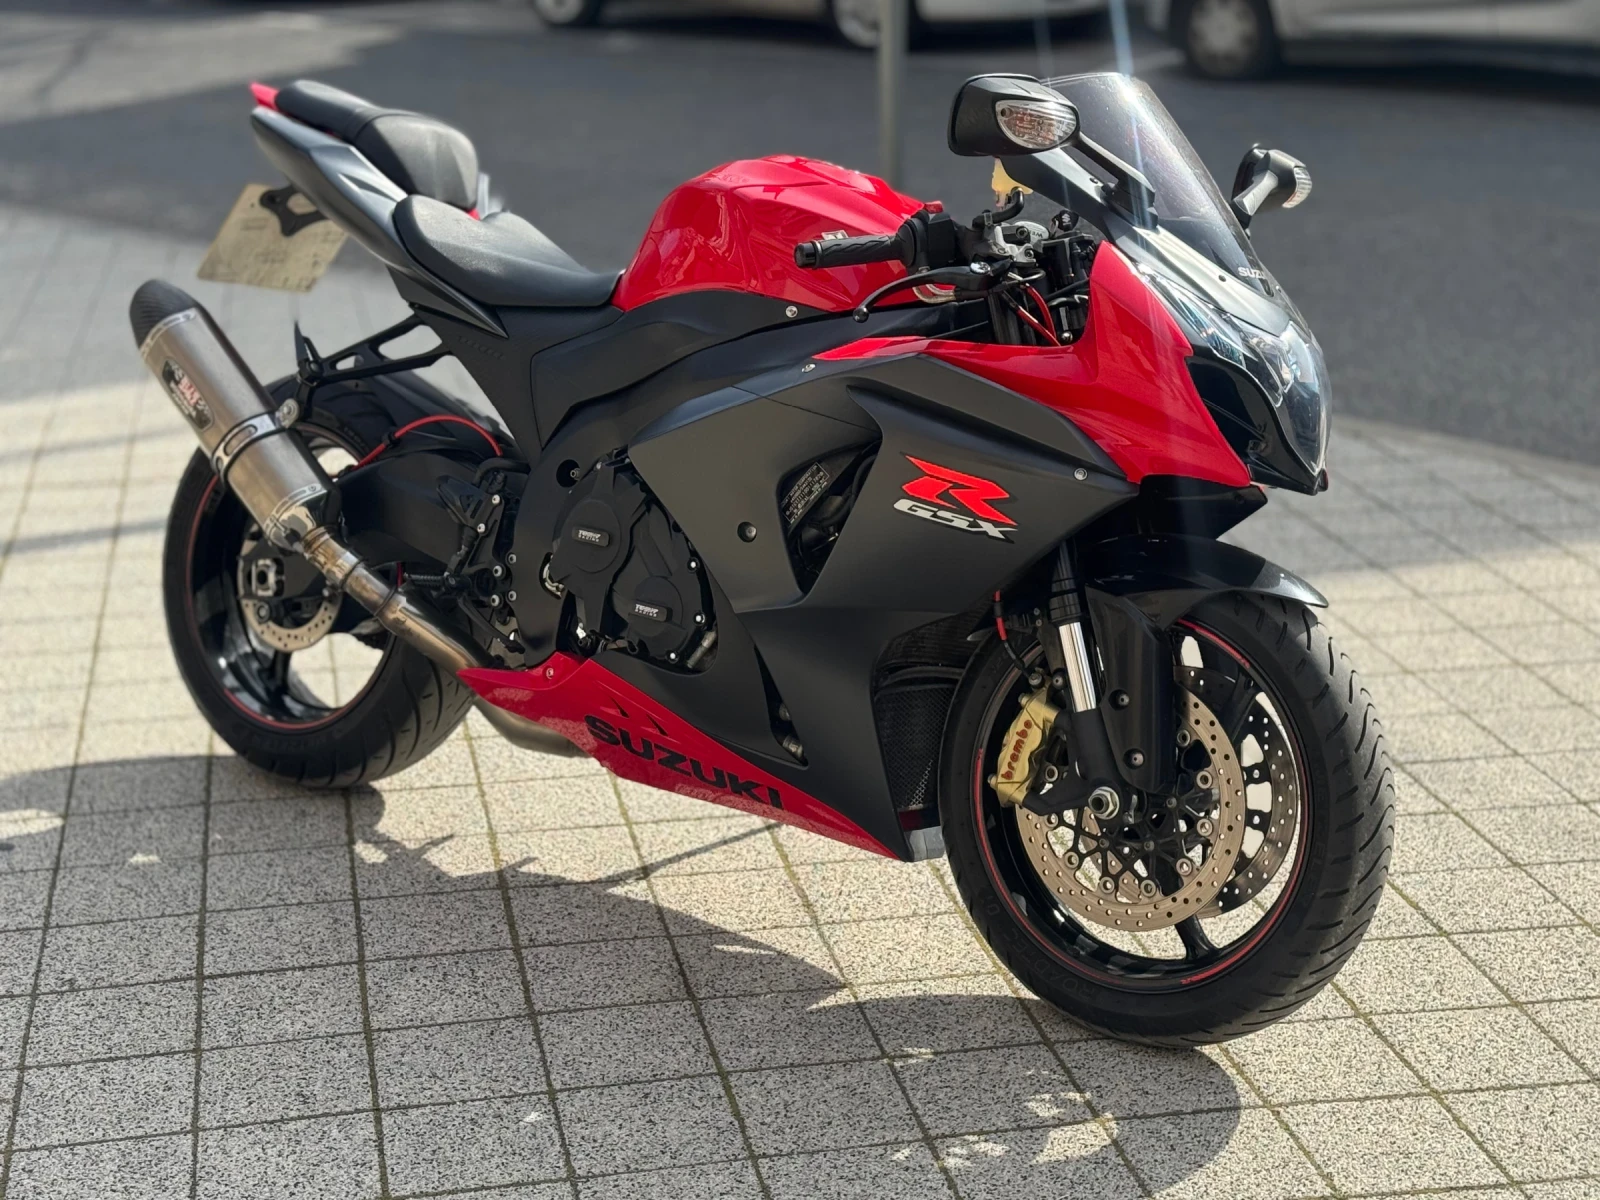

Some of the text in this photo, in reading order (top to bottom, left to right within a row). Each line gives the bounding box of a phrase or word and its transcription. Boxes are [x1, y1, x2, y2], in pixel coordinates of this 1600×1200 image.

[893, 499, 1018, 539] GSX
[901, 454, 1018, 526] R
[584, 714, 784, 810] SUZUKI
[1001, 719, 1032, 780] brembo
